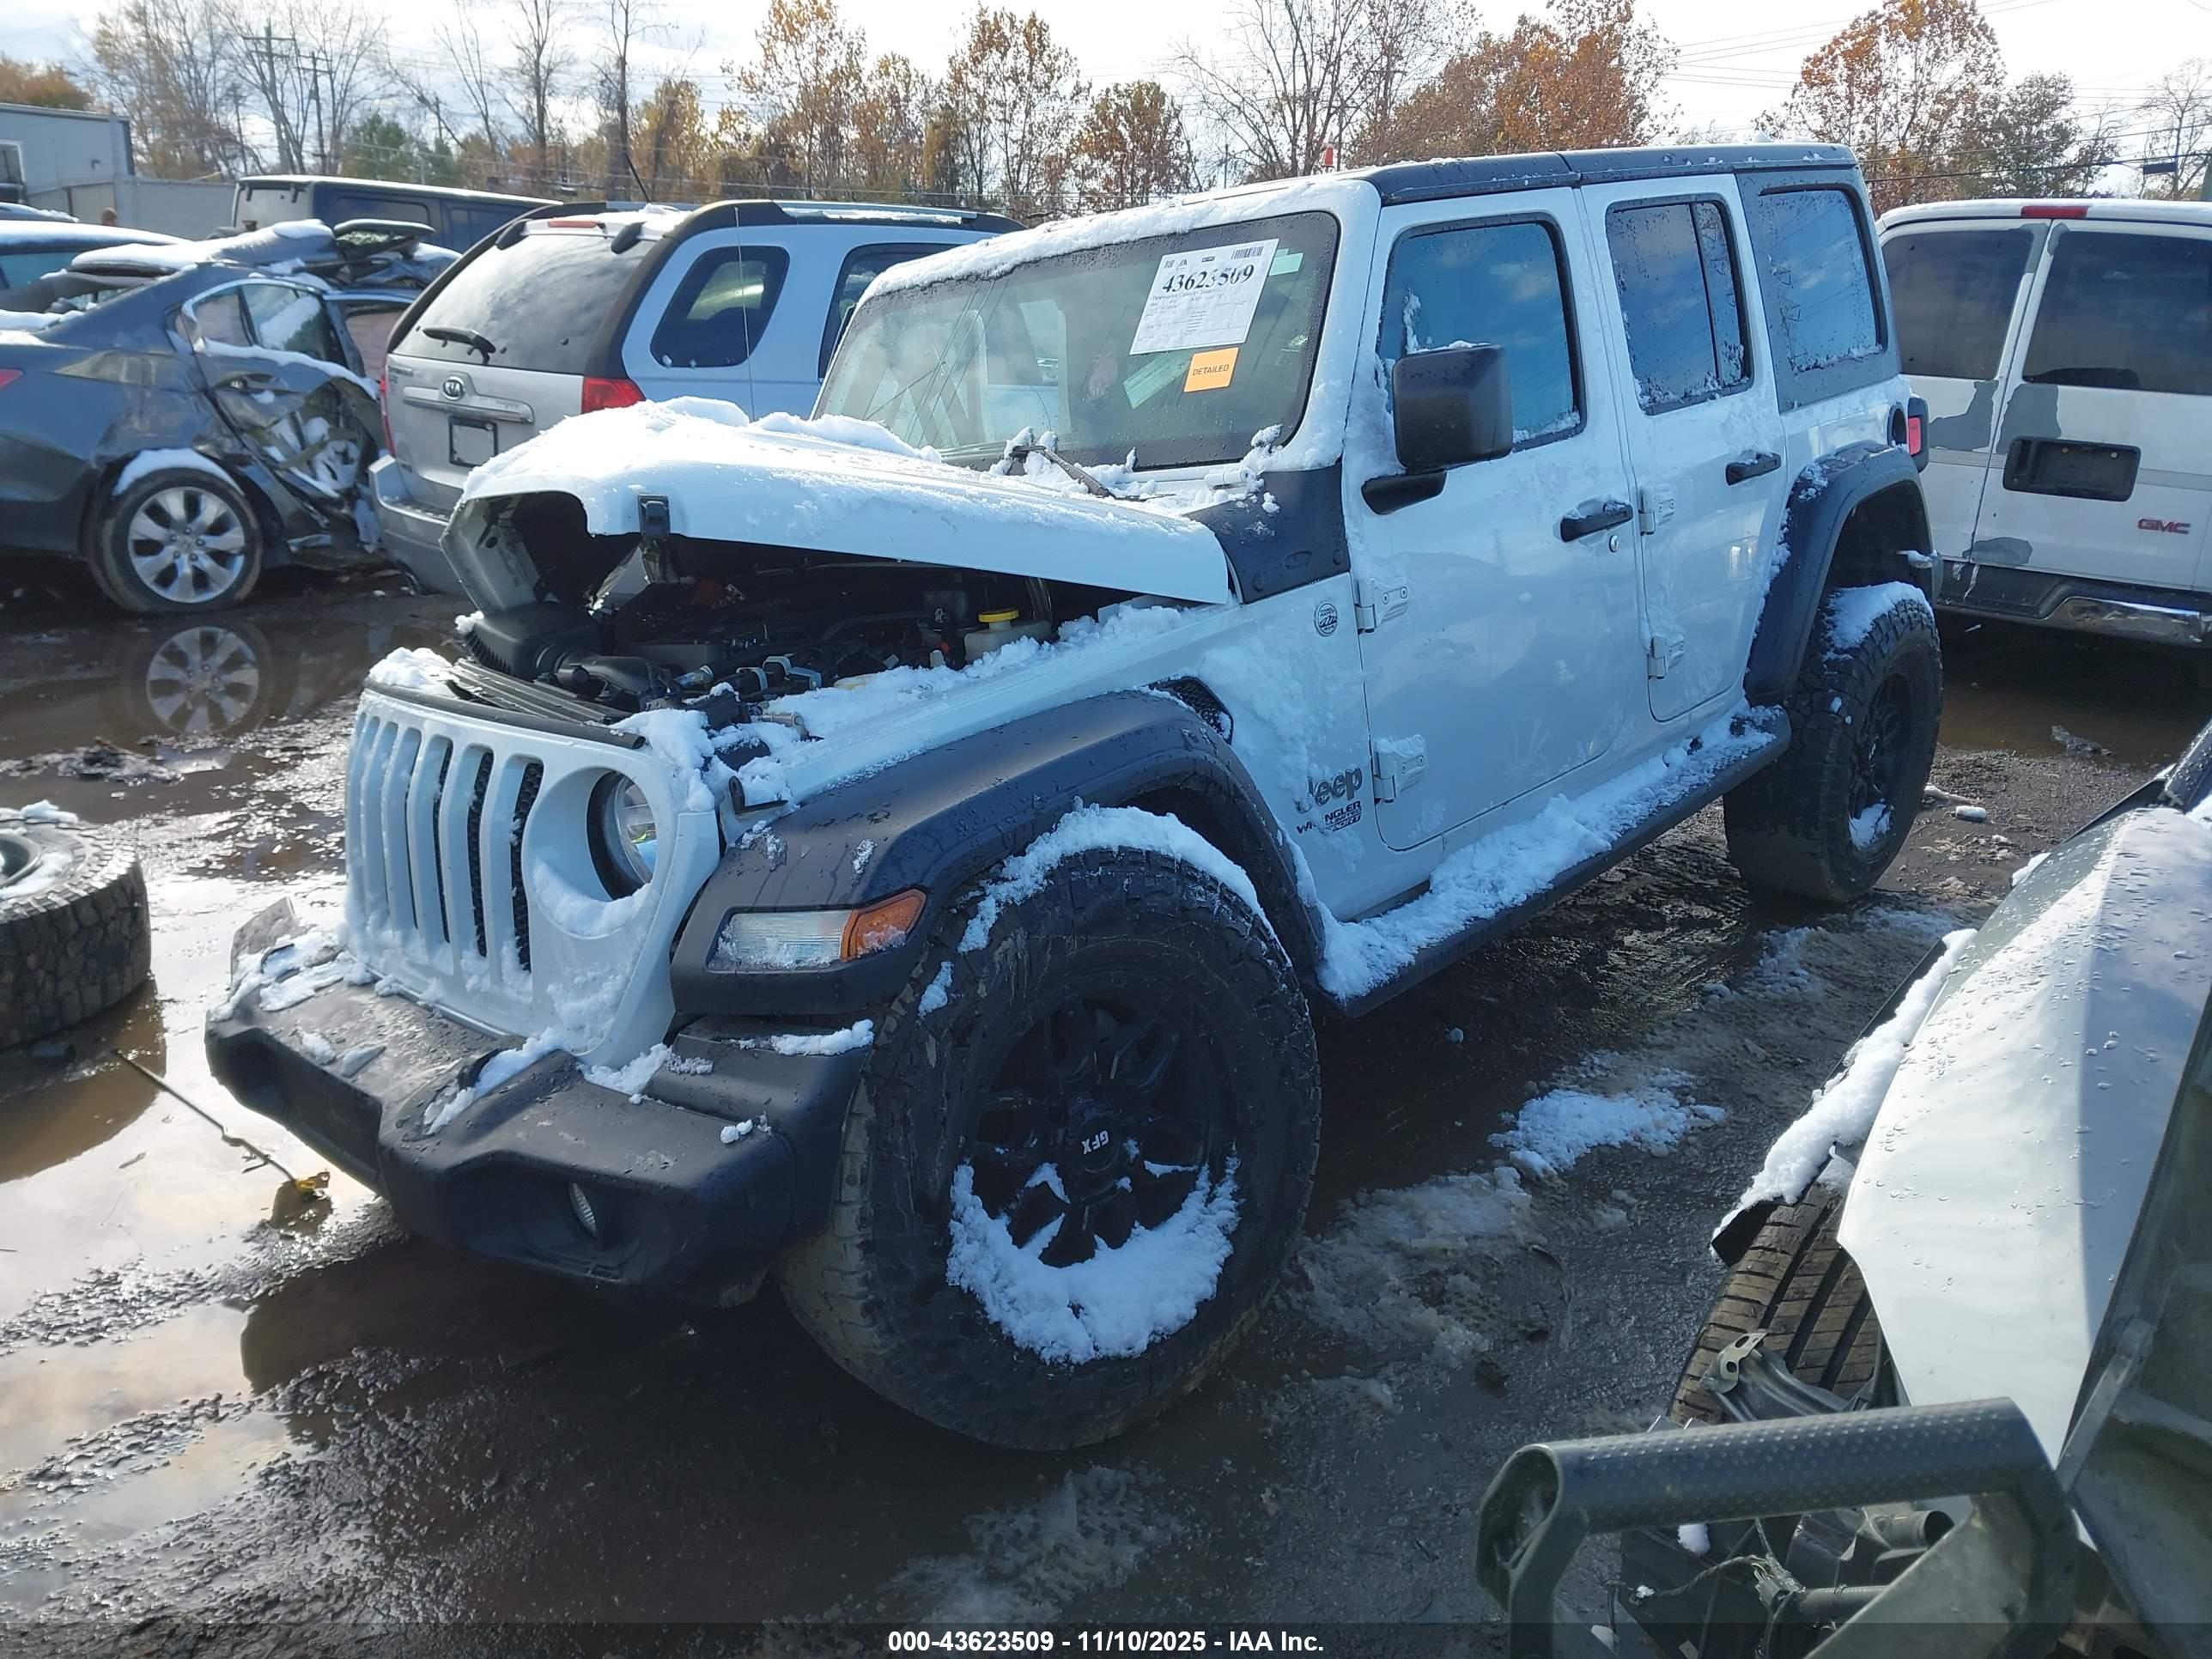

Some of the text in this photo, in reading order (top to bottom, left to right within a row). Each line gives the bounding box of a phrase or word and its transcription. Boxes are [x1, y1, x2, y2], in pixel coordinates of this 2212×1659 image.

[1192, 363, 1230, 376] DETAILED
[2137, 518, 2191, 535] GMC
[1081, 1130, 1109, 1155] GFX
